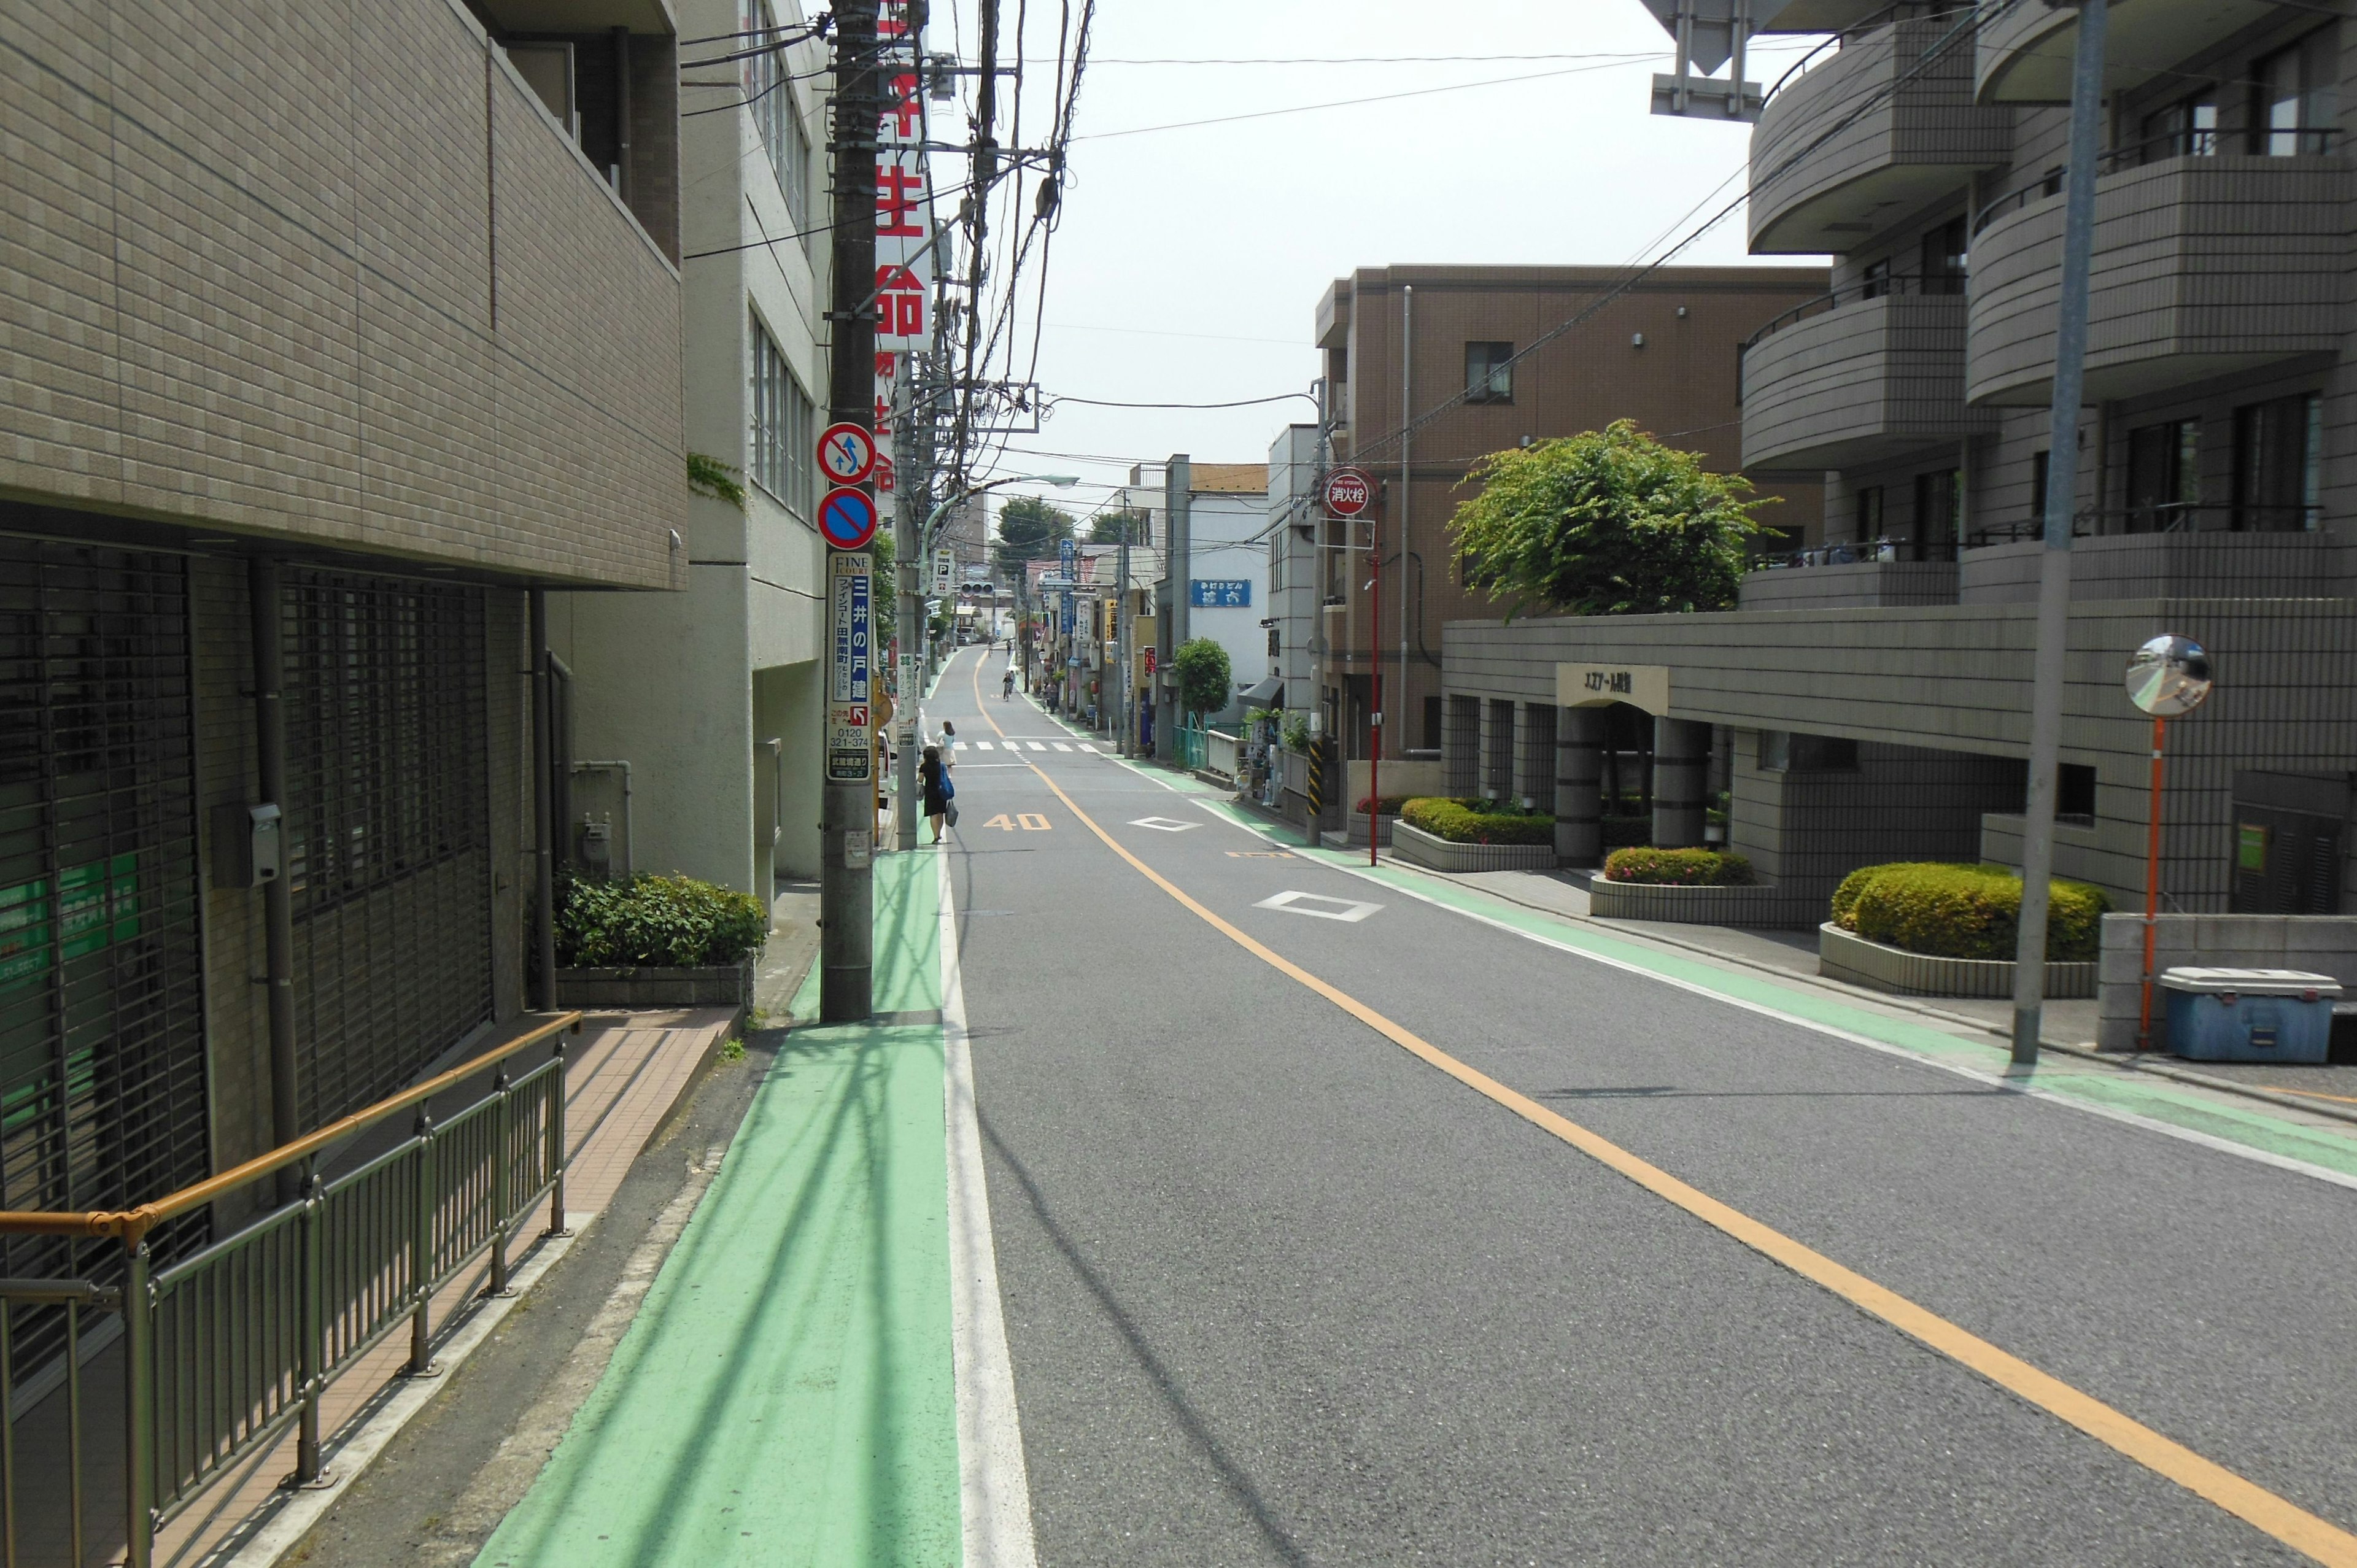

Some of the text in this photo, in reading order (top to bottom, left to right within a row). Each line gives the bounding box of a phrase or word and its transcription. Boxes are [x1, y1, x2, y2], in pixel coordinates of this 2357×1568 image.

[1331, 487, 1364, 503] 消火栓
[835, 557, 869, 574] FINE
[939, 565, 948, 574] P
[852, 579, 867, 699] 三井の戸建
[838, 728, 862, 737] 0120
[830, 738, 868, 747] 321-374
[983, 814, 1052, 831] 40
